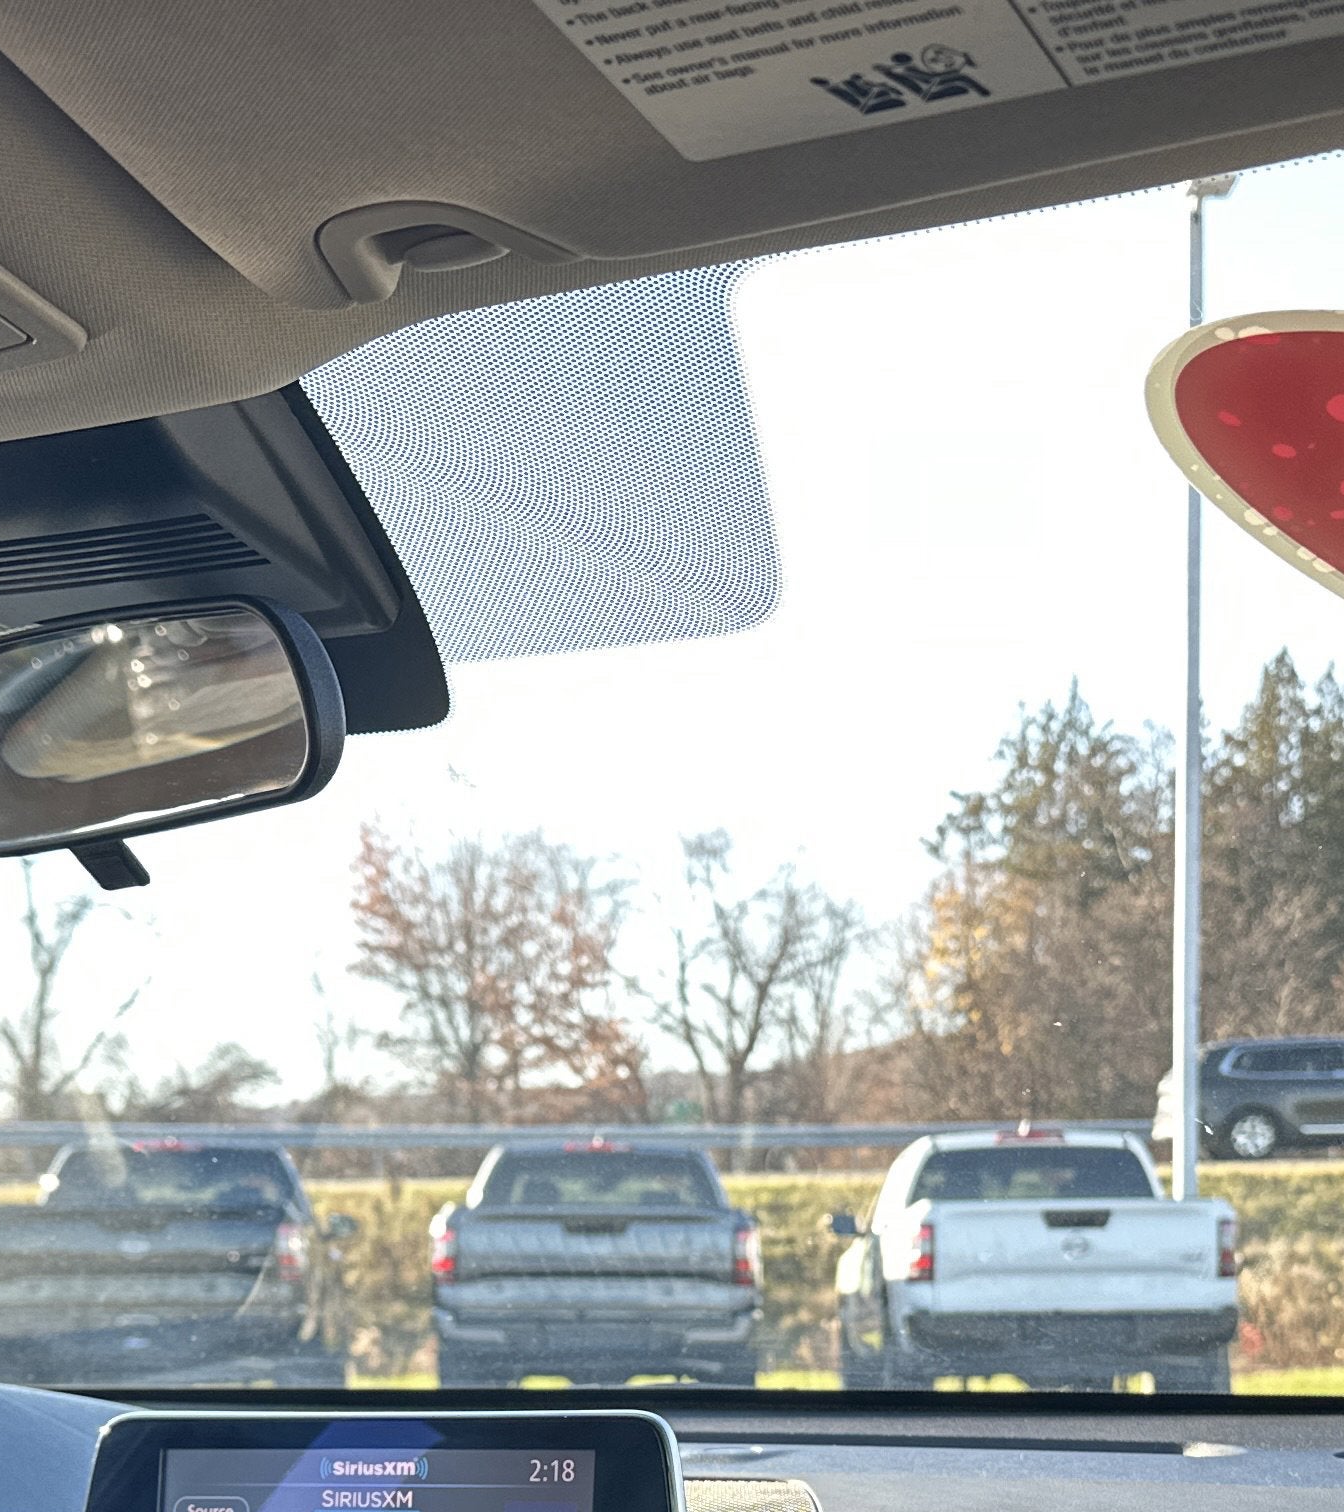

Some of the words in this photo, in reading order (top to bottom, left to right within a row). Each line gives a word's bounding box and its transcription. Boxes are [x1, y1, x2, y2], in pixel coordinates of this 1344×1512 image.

[615, 46, 672, 66] Always
[644, 78, 690, 96] about
[529, 1459, 576, 1482] 2:18
